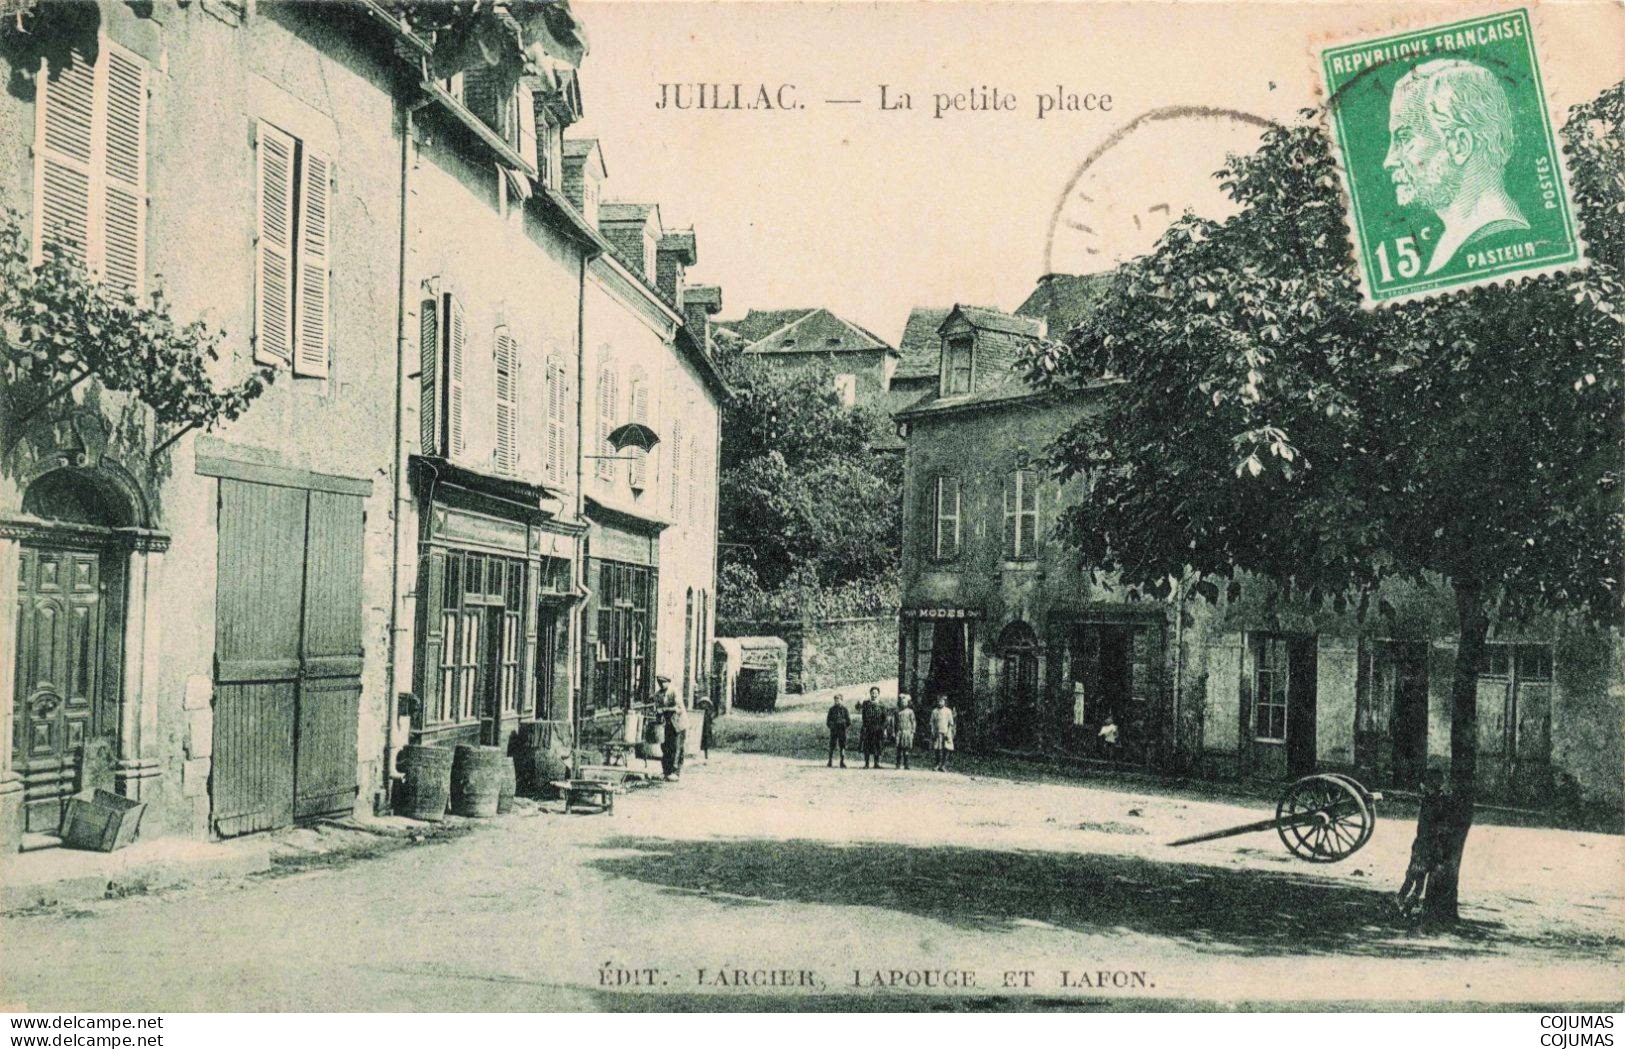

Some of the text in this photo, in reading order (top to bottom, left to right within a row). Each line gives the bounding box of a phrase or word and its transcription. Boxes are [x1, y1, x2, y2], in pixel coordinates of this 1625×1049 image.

[1536, 156, 1558, 210] POSTES
[1466, 242, 1536, 269] PASTEUR
[919, 608, 965, 618] MODES
